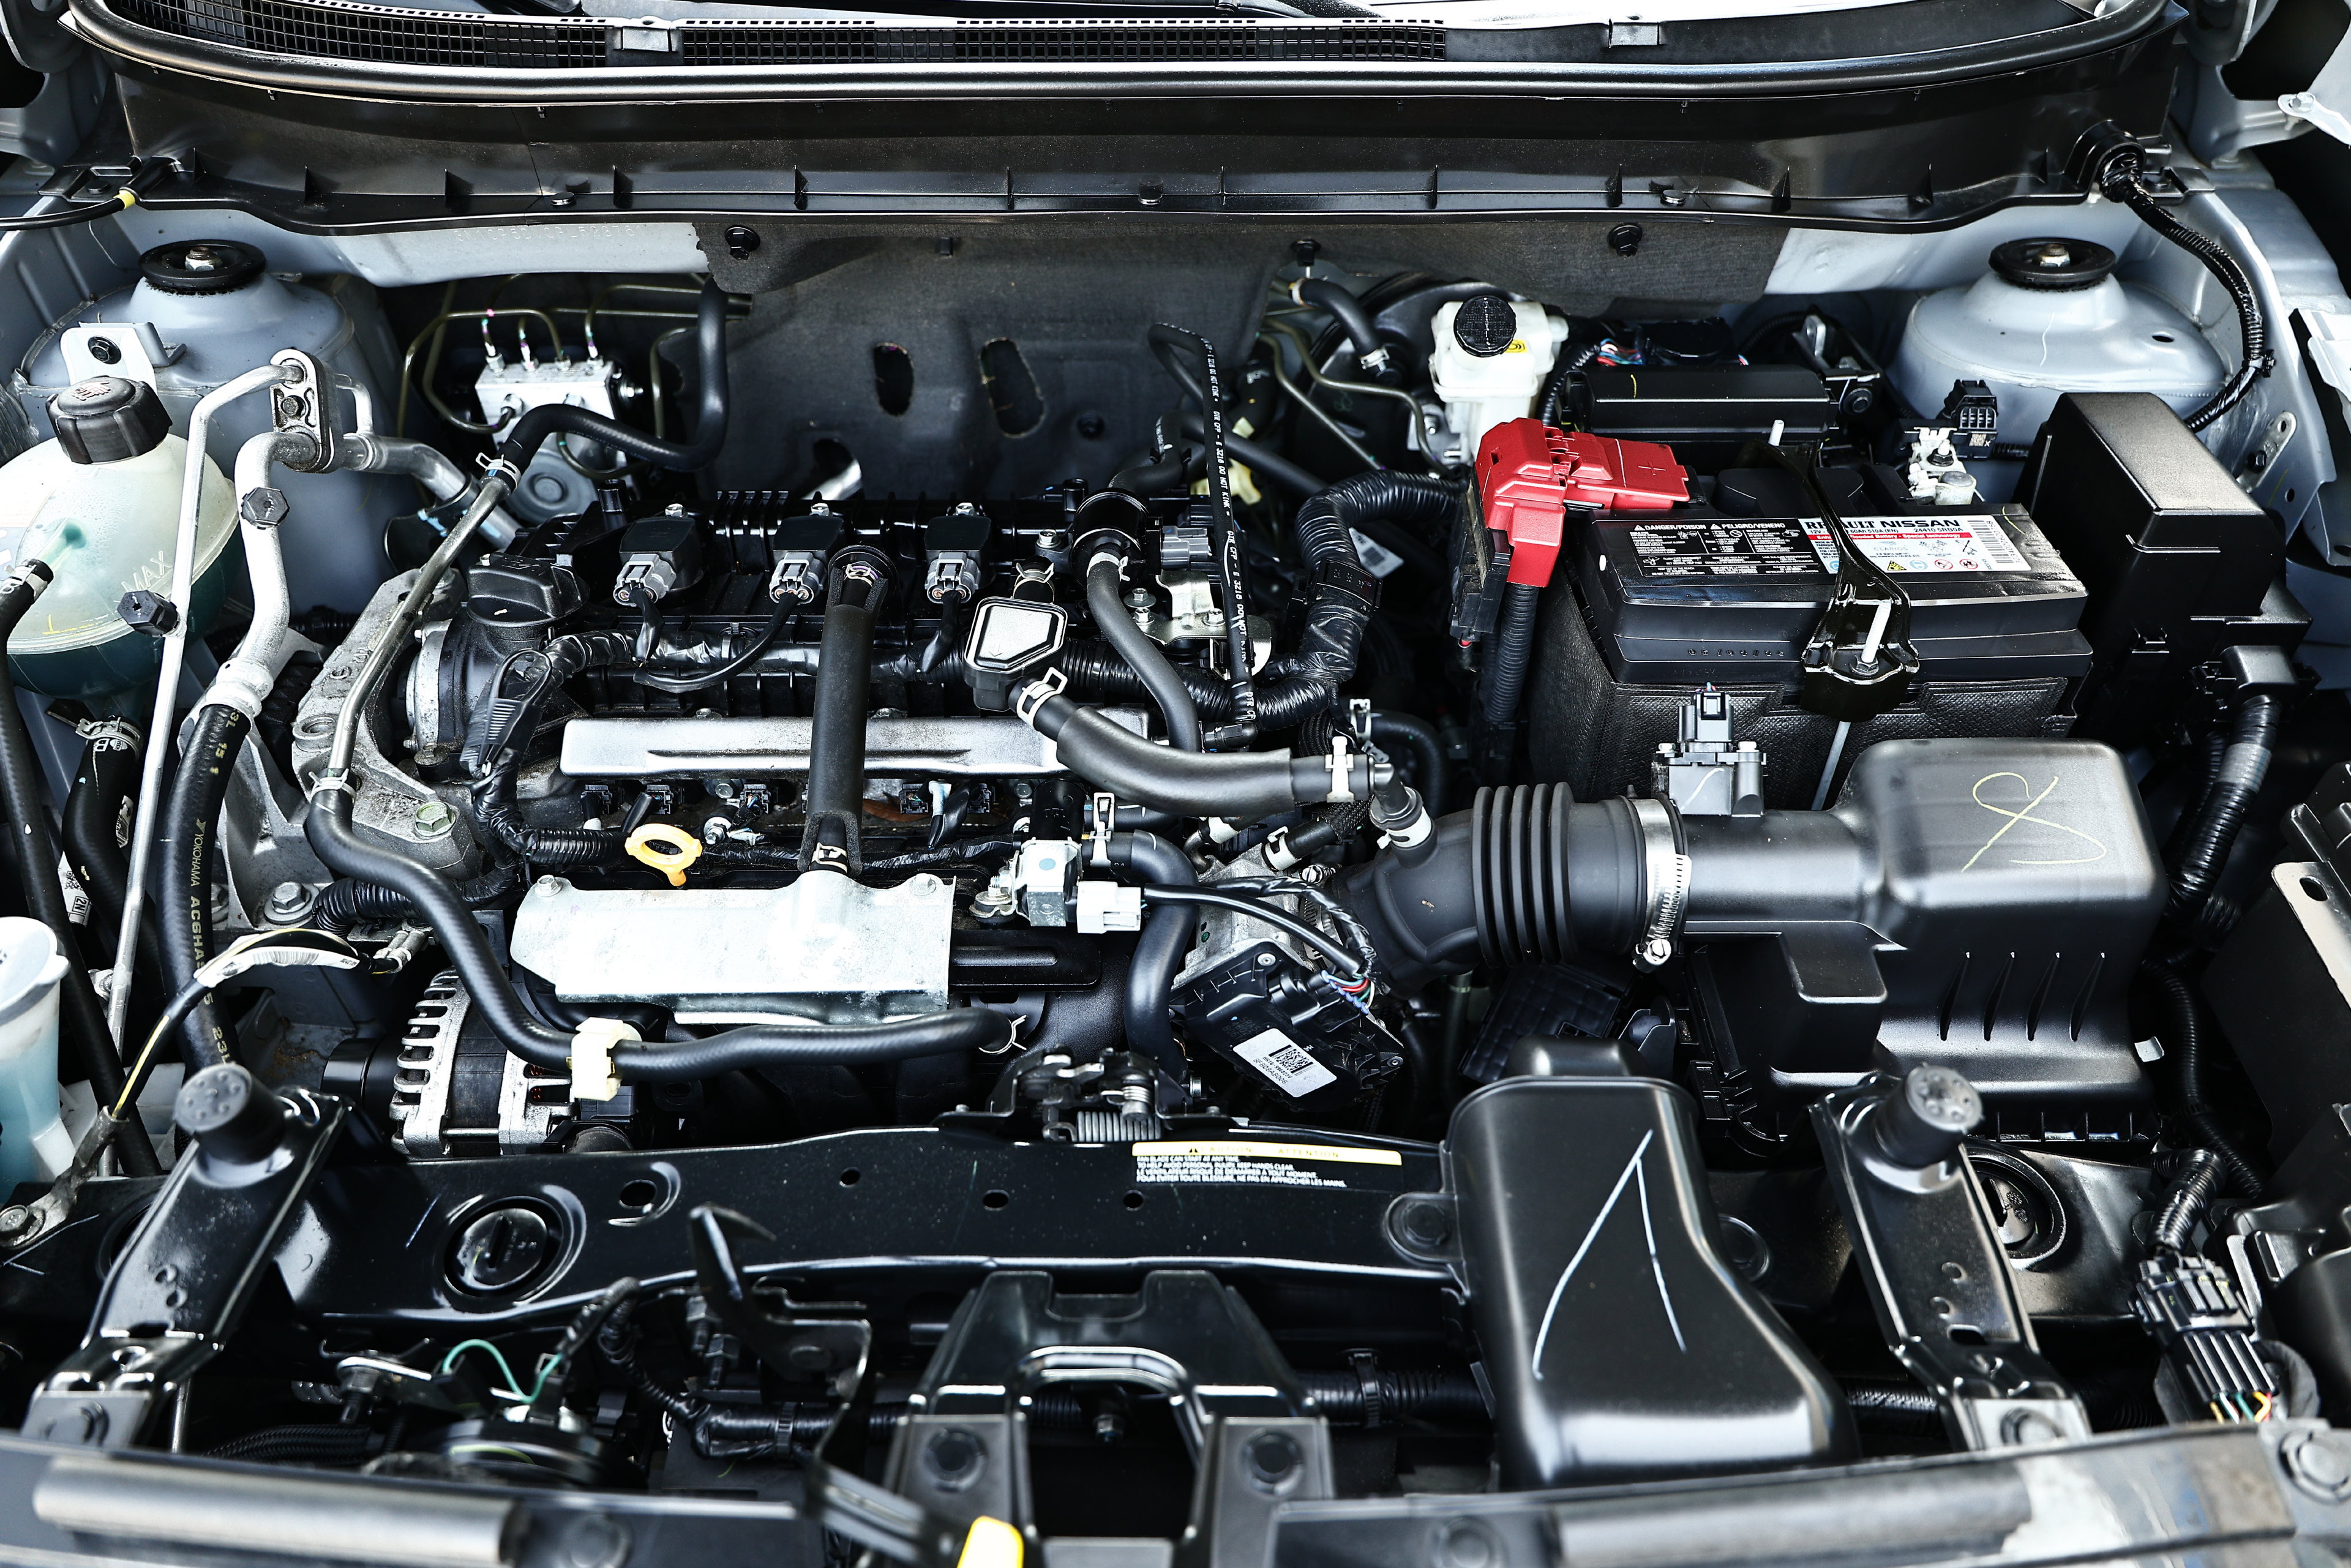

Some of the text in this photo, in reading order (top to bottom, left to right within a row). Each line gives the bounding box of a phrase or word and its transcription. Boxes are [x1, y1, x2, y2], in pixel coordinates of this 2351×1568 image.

[121, 550, 173, 591] MAX
[190, 832, 205, 887] YOKOHAMA
[1278, 1148, 1340, 1158] ATTENTION
